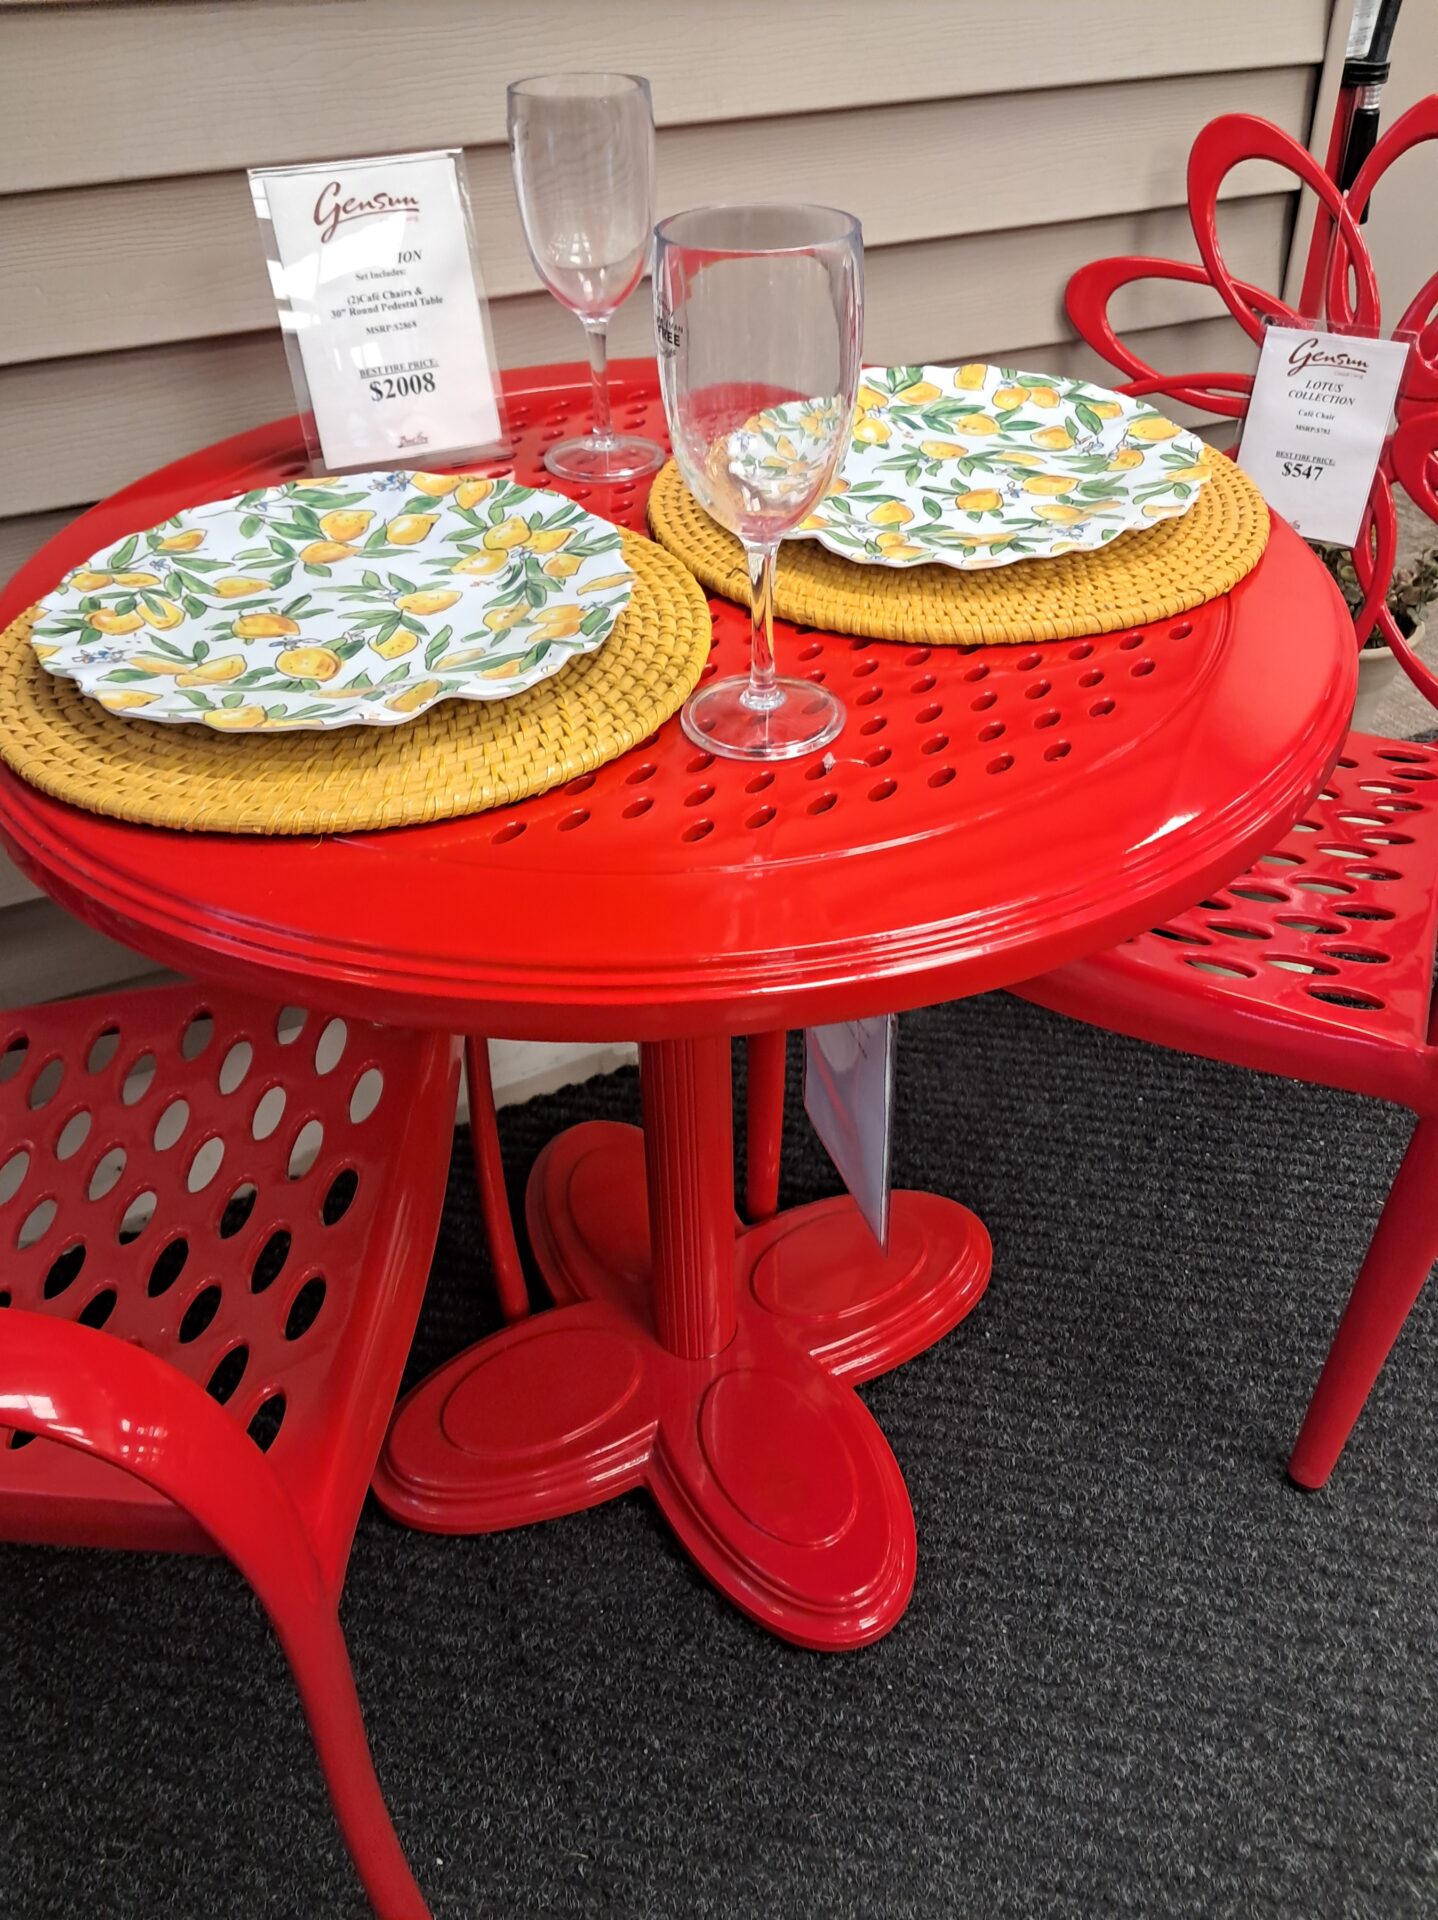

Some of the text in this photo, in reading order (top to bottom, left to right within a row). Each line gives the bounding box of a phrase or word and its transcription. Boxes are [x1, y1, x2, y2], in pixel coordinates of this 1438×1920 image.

[313, 181, 420, 243] Gensun
[382, 289, 412, 301] Chairs
[414, 286, 422, 296] &
[349, 304, 379, 317] Round
[381, 299, 418, 312] Pedestal
[420, 295, 443, 307] Table
[1287, 338, 1369, 377] Gensun
[360, 366, 382, 379] BEST
[384, 362, 405, 376] FIRE
[369, 372, 436, 402] $2008
[1305, 380, 1344, 393] LOTUS
[1288, 390, 1356, 406] COLLECTION
[1315, 411, 1335, 421] Chair
[1275, 450, 1293, 460] BEST
[1294, 453, 1310, 463] FIRE
[1281, 461, 1324, 481] $547
